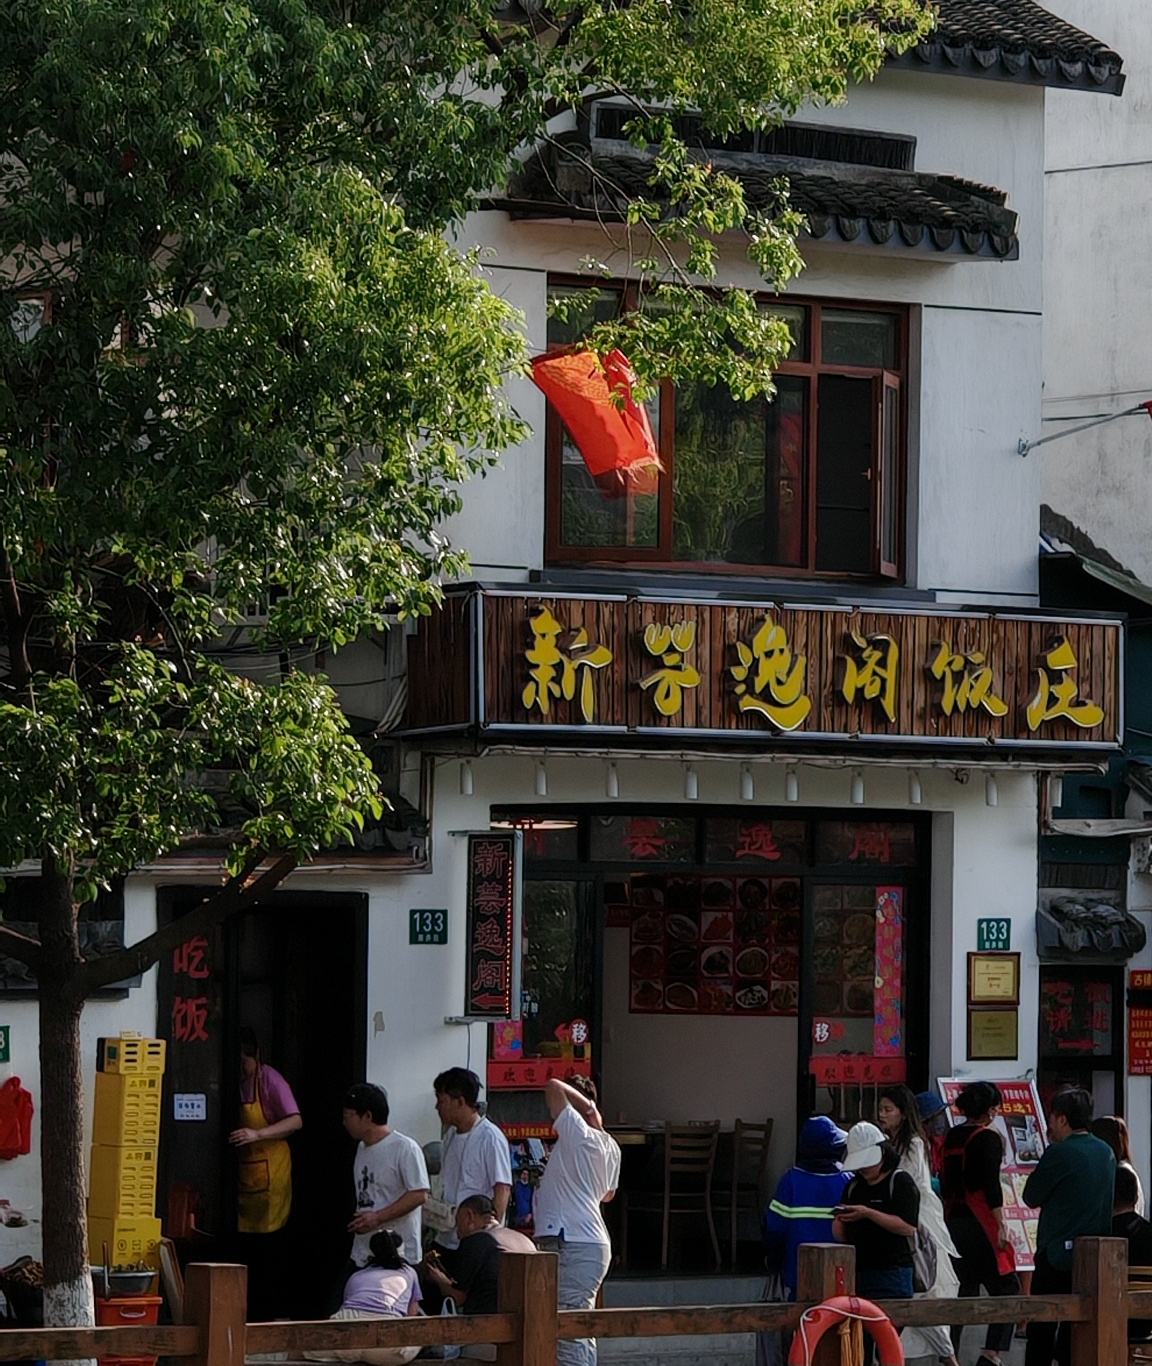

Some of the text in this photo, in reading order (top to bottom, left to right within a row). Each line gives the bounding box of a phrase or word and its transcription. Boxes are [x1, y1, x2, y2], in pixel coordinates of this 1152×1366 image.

[413, 911, 444, 933] 133
[472, 841, 509, 992] 新芸逸阁
[980, 920, 1008, 941] 133
[172, 937, 210, 1042] 吃饭
